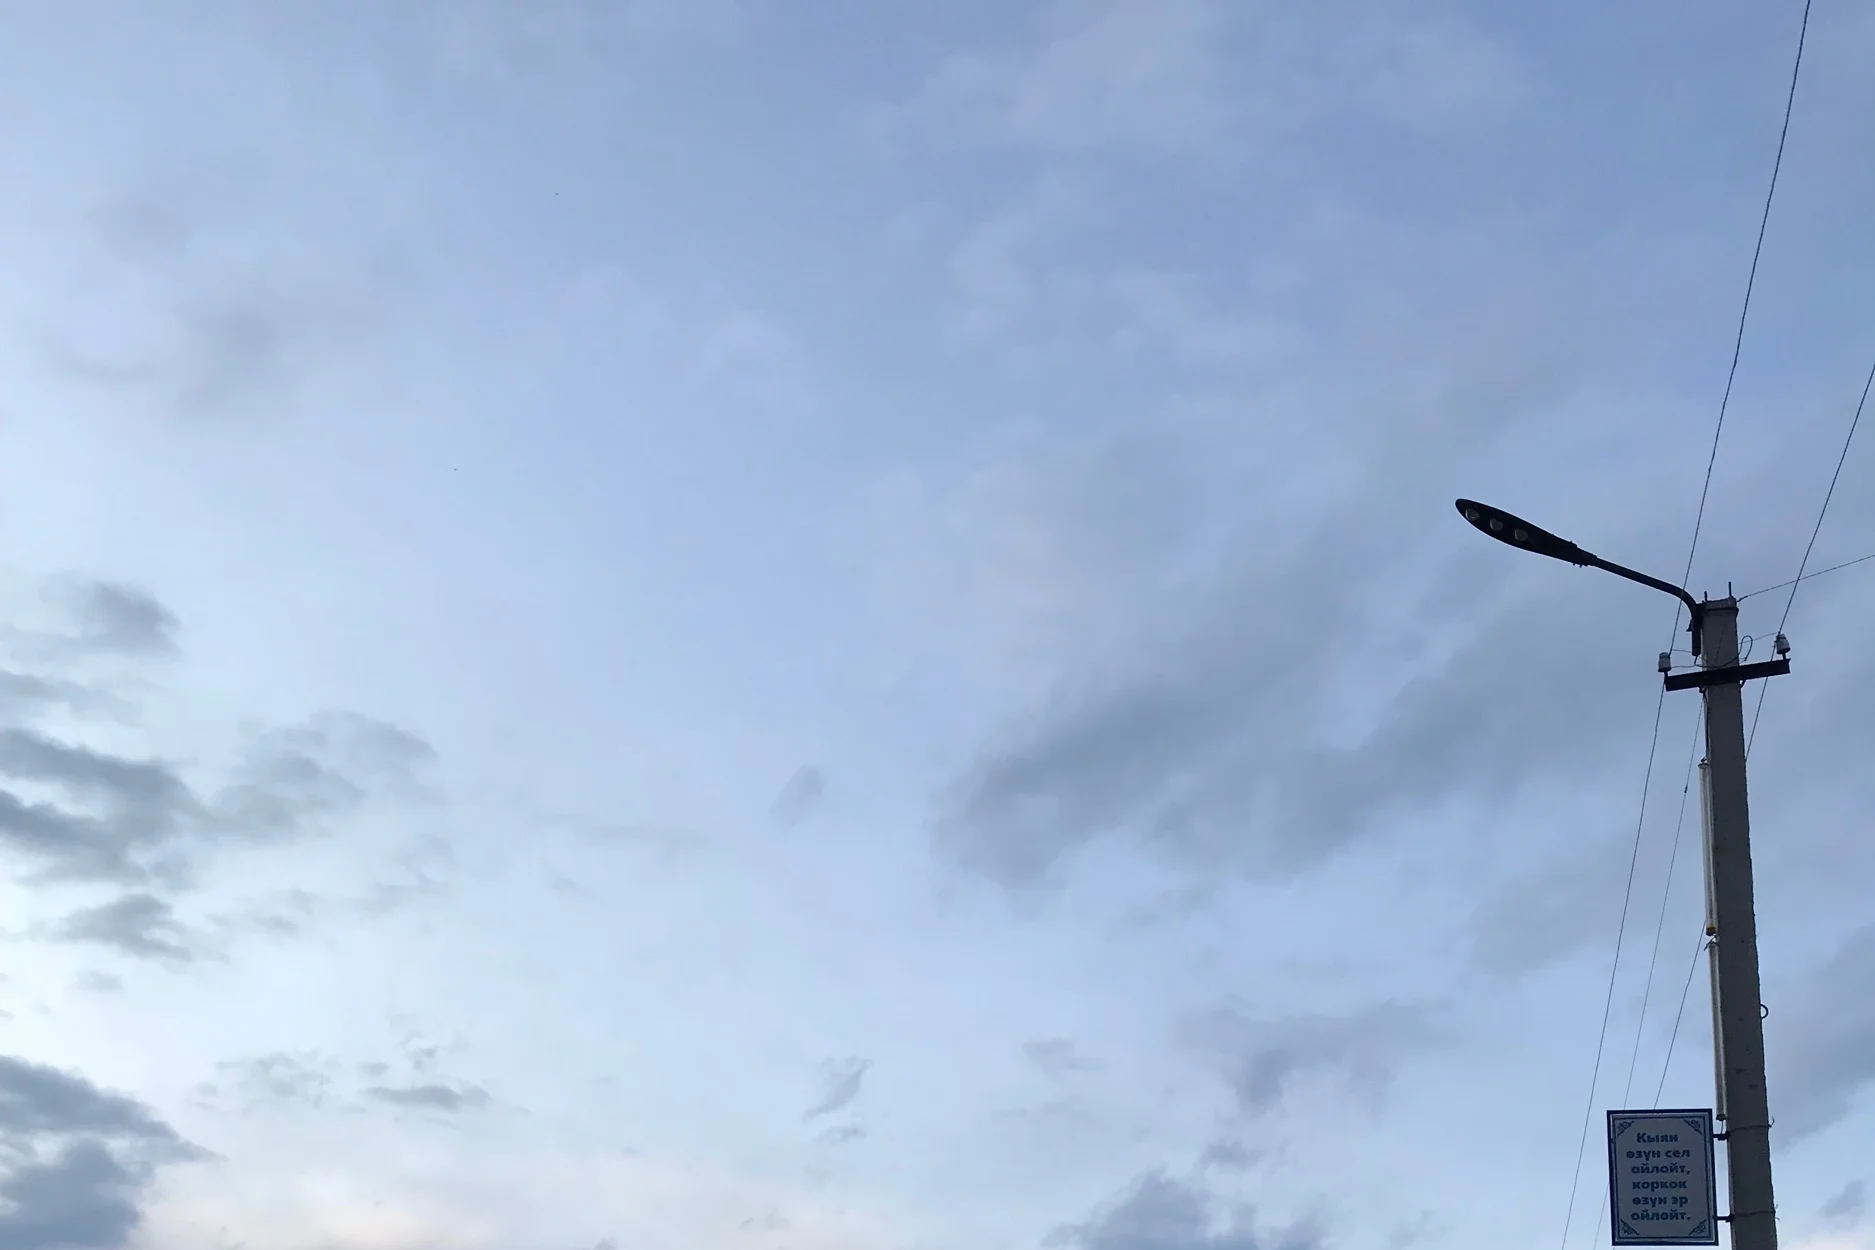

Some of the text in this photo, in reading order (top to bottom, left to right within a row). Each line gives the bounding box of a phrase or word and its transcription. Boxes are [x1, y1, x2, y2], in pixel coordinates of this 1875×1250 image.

[1665, 1149, 1690, 1158] сел
[1632, 1180, 1687, 1192] коркок
[1671, 1197, 1689, 1207] эр
[1631, 1209, 1691, 1221] ойлойт.
